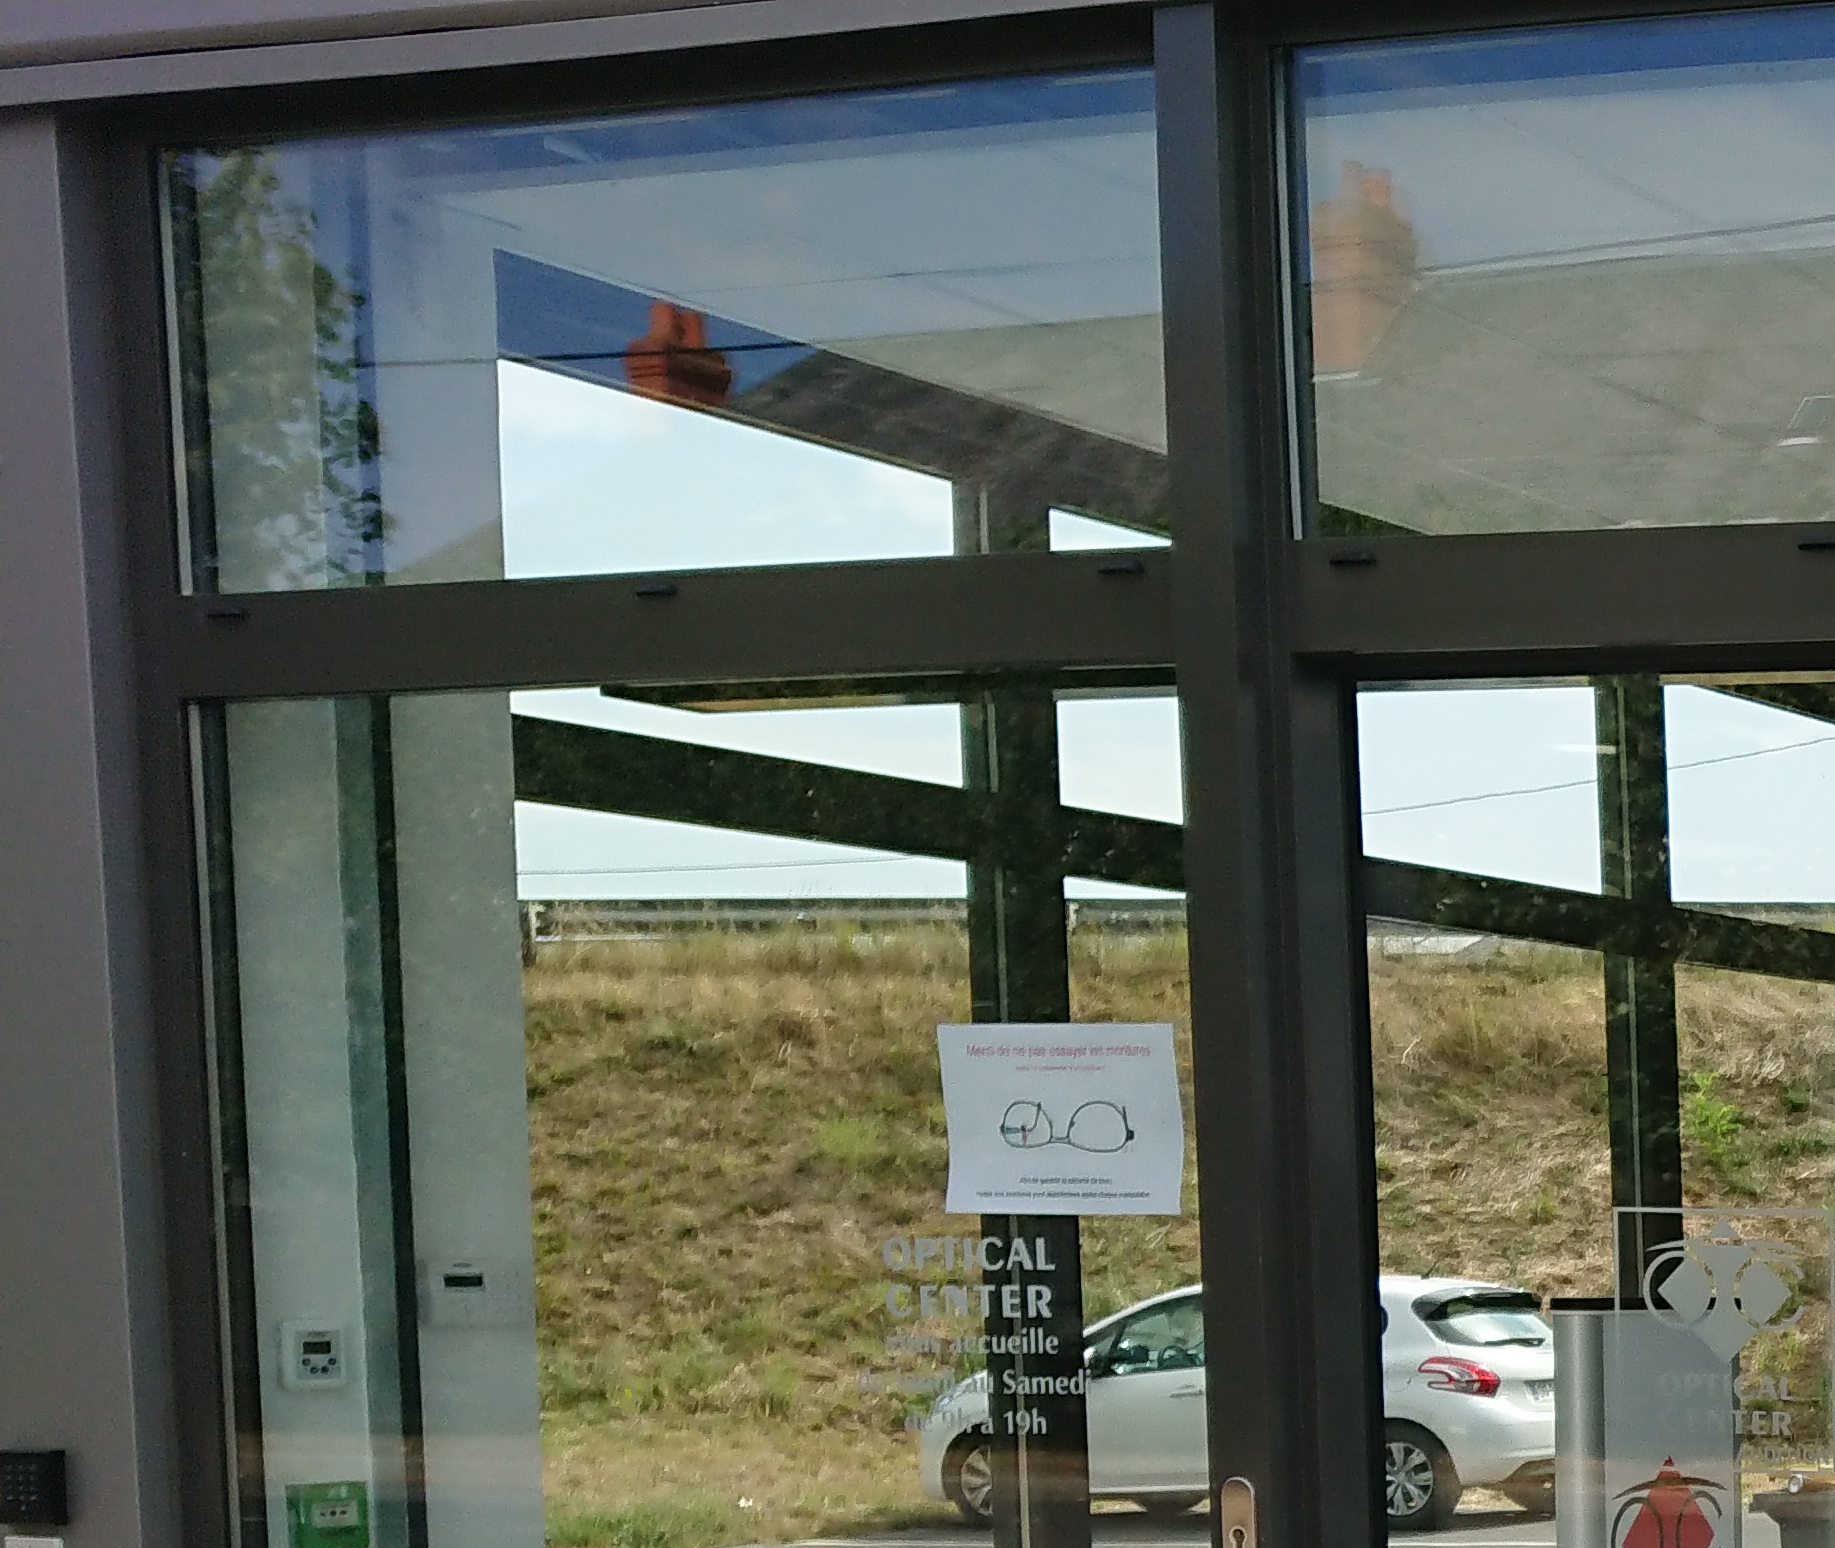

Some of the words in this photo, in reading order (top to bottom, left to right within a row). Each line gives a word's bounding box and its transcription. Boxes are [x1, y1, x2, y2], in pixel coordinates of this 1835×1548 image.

[882, 1236, 1056, 1271] OPTICAL
[886, 1283, 1053, 1319] CENTER
[949, 1326, 1059, 1355] accueille
[1002, 1368, 1092, 1395] Samedi
[1003, 1407, 1047, 1435] 19h
